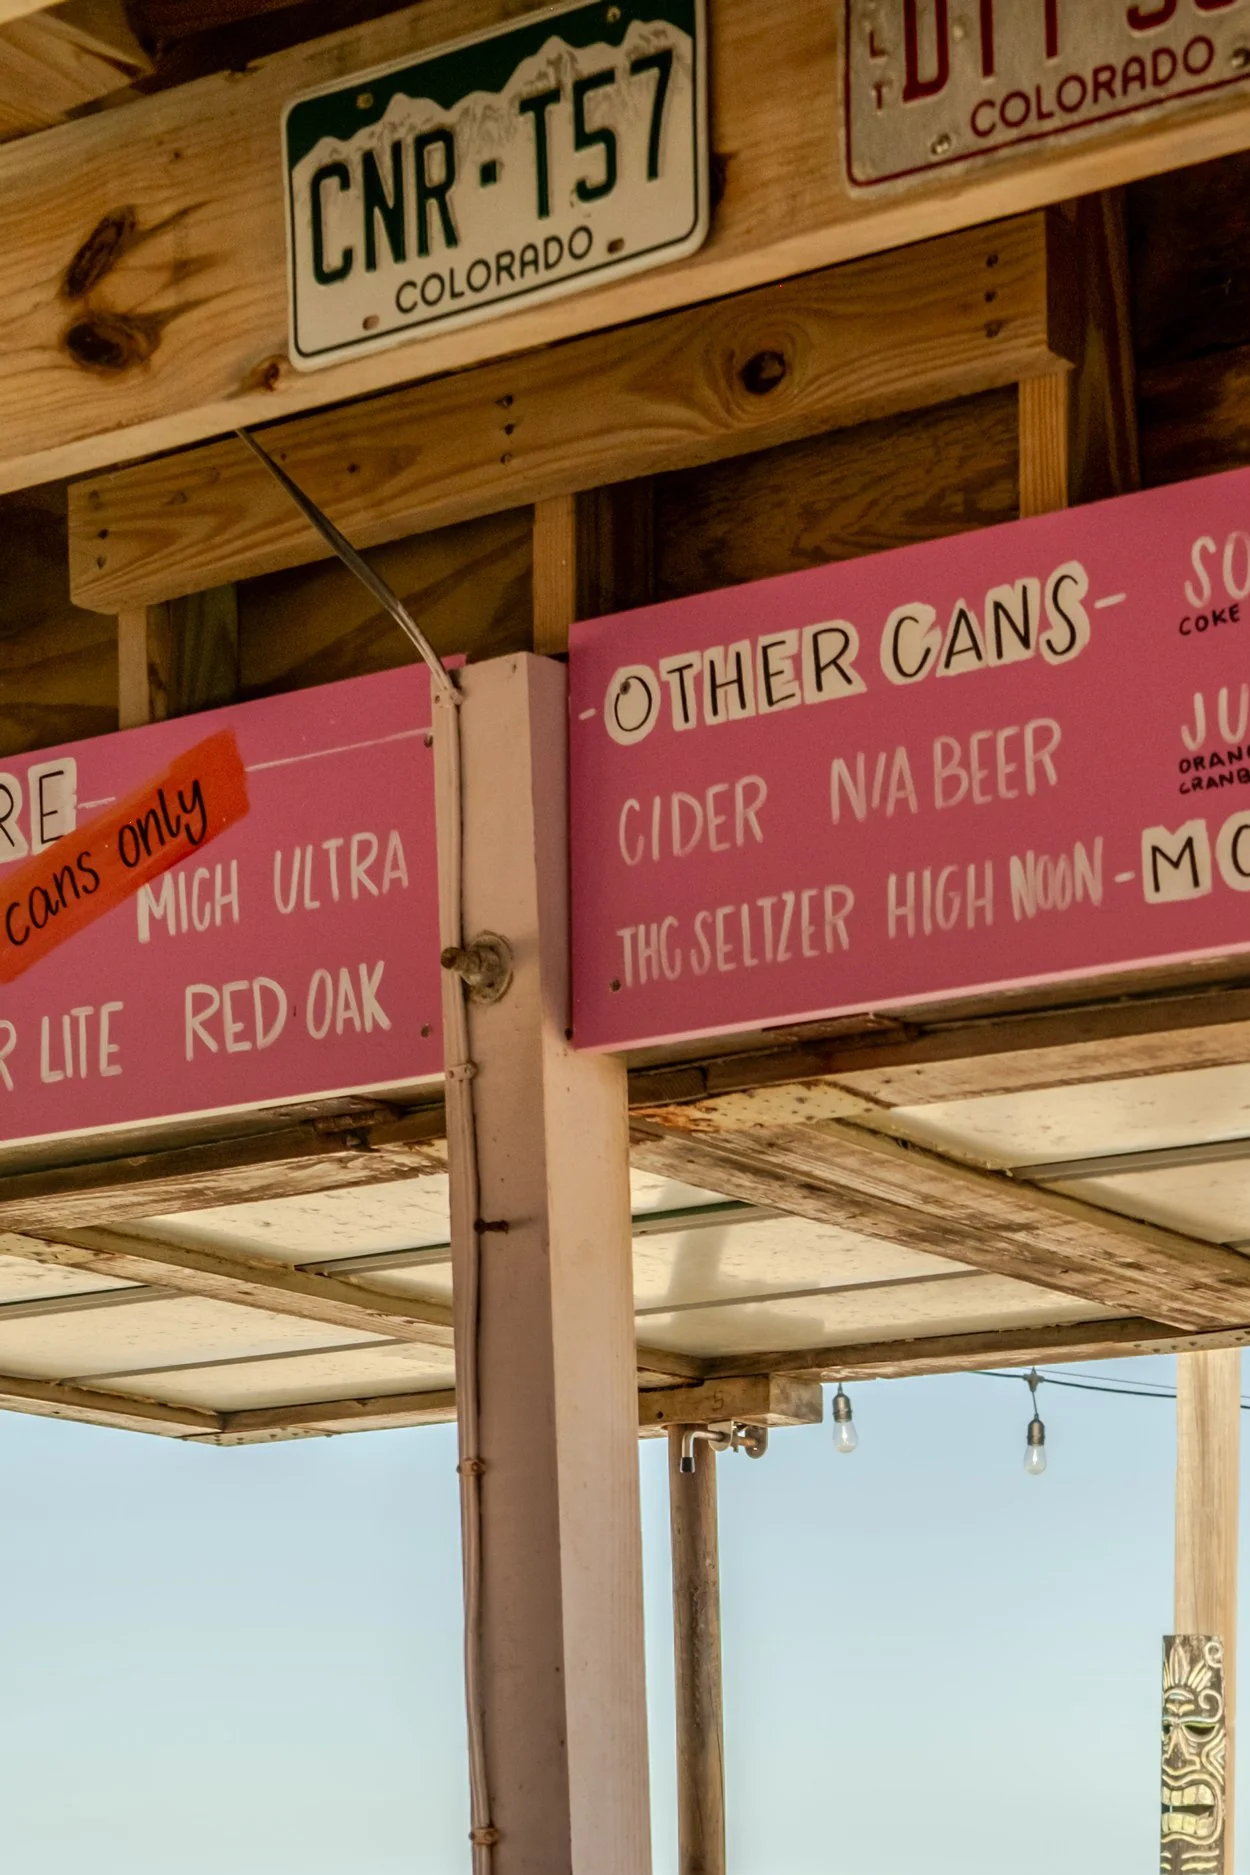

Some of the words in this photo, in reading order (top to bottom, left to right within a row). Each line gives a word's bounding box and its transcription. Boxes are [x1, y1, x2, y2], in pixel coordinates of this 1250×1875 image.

[971, 35, 1215, 137] COLORADO
[395, 225, 593, 314] COLORADO
[605, 619, 867, 746] OTHER
[880, 560, 1090, 686] CANS
[1179, 605, 1241, 636] COKE
[619, 775, 768, 866] CIDER
[831, 746, 918, 824] N/A
[932, 718, 1062, 810] BEER
[5, 851, 100, 946] cans
[118, 779, 208, 868] only
[136, 859, 239, 943] MICH
[274, 829, 409, 914] ULTRA
[887, 860, 993, 940] HIGH
[1010, 836, 1104, 921] NOON
[616, 916, 682, 988] THC
[690, 885, 855, 976] SELTZER
[41, 1001, 124, 1083] LITE
[185, 976, 288, 1061] RED
[306, 960, 392, 1040] OAK
